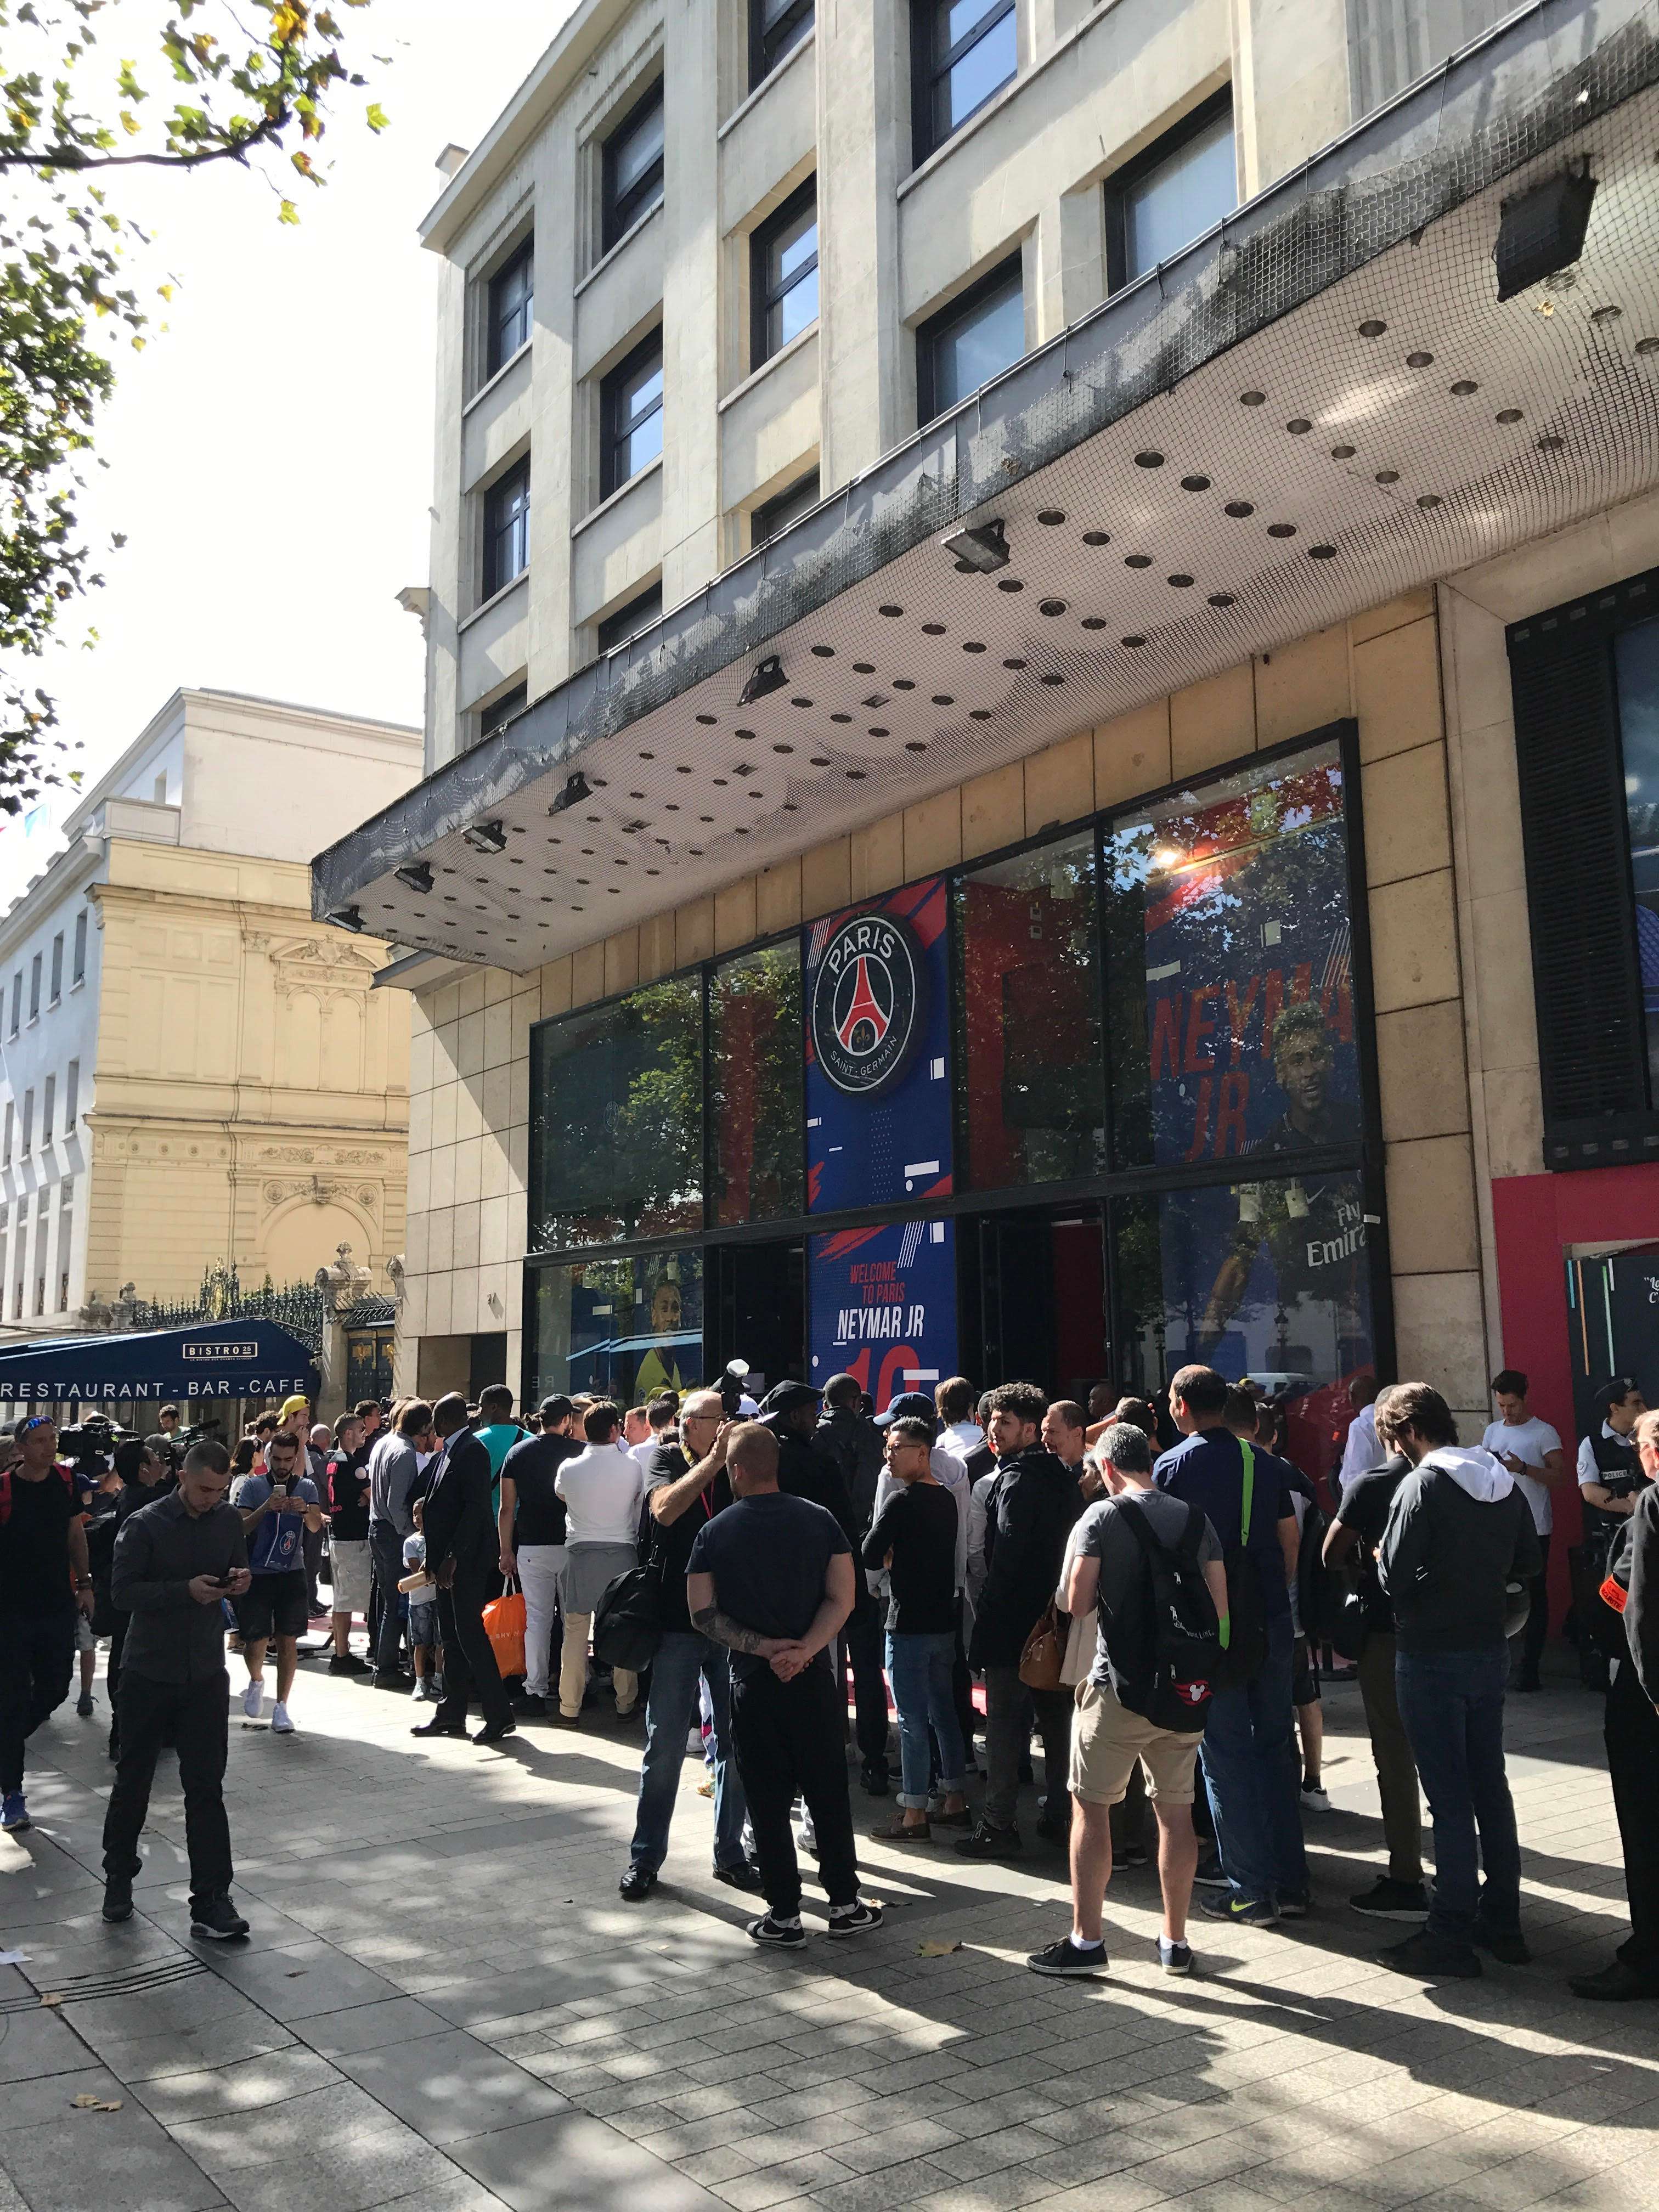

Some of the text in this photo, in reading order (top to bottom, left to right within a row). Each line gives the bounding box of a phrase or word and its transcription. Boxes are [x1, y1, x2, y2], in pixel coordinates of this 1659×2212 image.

[828, 926, 895, 974] PARIS
[1184, 1071, 1250, 1162] JR
[1337, 1201, 1361, 1227] Fly
[850, 1261, 896, 1284] WELCOME
[862, 1282, 905, 1305] TO PARIS
[837, 1305, 924, 1340] NEYMAR JR
[189, 1346, 239, 1356] BISTRO
[1, 1381, 164, 1398] RESTAURANT
[188, 1380, 229, 1396] BAR
[1602, 1470, 1628, 1480] POLICE
